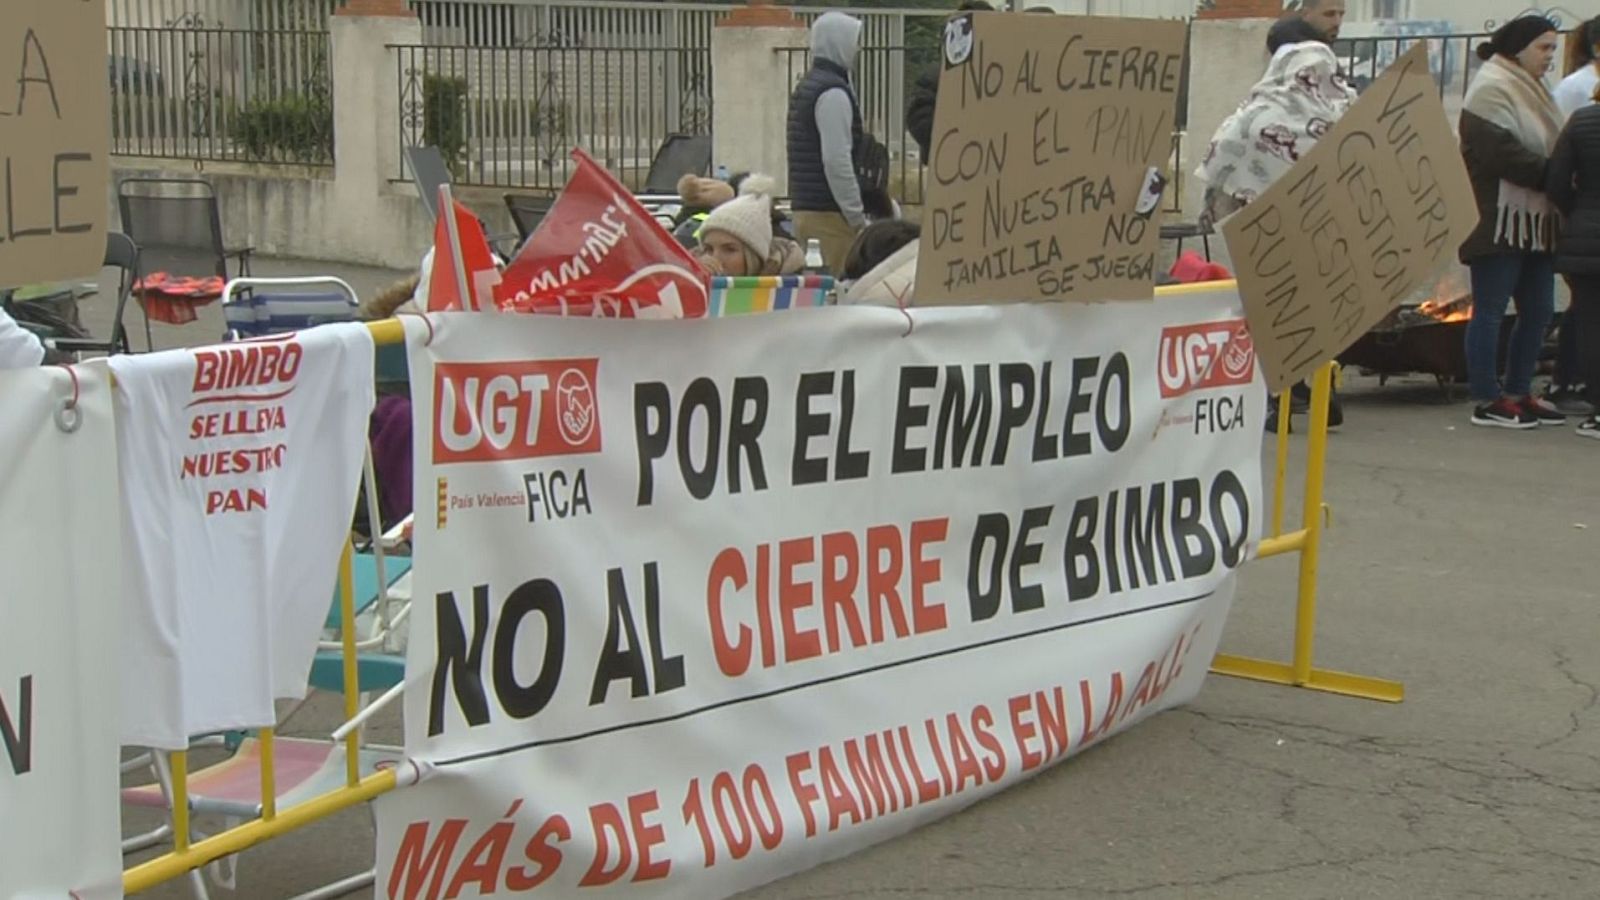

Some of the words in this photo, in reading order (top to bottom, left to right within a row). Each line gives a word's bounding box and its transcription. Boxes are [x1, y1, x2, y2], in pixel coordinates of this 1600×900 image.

[0, 27, 61, 119] A
[961, 40, 1004, 109] NO
[1013, 49, 1042, 95] AL
[1056, 35, 1180, 92] CIERRE
[934, 127, 1008, 186] CON
[1033, 106, 1070, 166] EL
[1086, 104, 1166, 166] PAN
[1376, 60, 1450, 262] VUESTRA
[0, 152, 92, 242] LE
[932, 202, 966, 250] DE
[982, 176, 1116, 249] NUESTRA
[1102, 213, 1146, 248] NO
[1337, 130, 1414, 302] GESTIÓN
[943, 235, 1063, 293] FAMILIA
[1037, 264, 1079, 297] SE
[1082, 252, 1154, 282] JUEGA
[1286, 163, 1366, 343] NUESTRA
[1240, 204, 1324, 382] RUINA!
[192, 342, 304, 393] BIMBO
[1161, 330, 1231, 390] UGT
[440, 373, 550, 453] UGT
[634, 376, 769, 507] POR
[791, 369, 871, 487] EL
[890, 351, 1131, 475] EMPLEO
[1194, 394, 1244, 435] FICA
[206, 488, 267, 515] PAN
[451, 494, 474, 510] País
[523, 468, 593, 523] FICA
[427, 577, 566, 738] NO
[588, 561, 686, 706] AL
[706, 517, 950, 678] CIERRE
[966, 505, 1055, 622] DE
[1063, 469, 1249, 603] BIMBO
[387, 798, 572, 900] MÁS
[577, 789, 672, 887] DE
[681, 763, 784, 868] 100
[785, 704, 1006, 839] FAMILIAS
[1008, 686, 1069, 773] EN
[1078, 672, 1123, 747] LA
